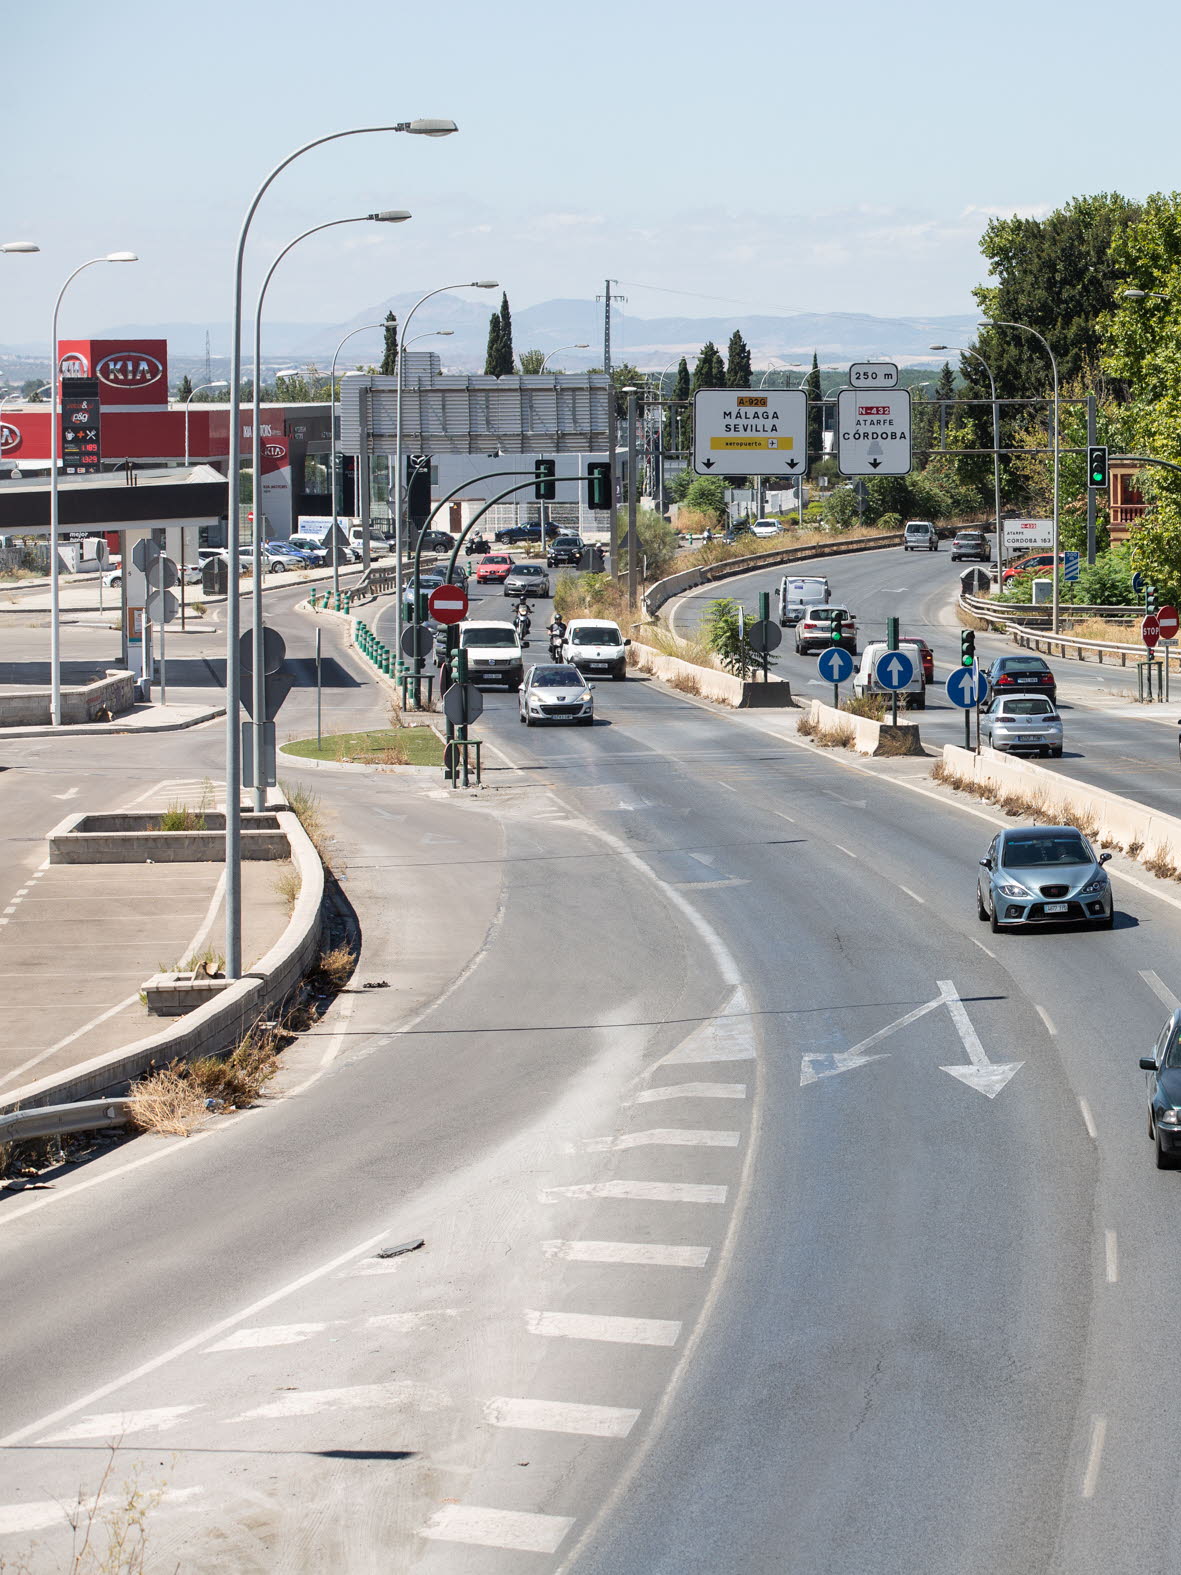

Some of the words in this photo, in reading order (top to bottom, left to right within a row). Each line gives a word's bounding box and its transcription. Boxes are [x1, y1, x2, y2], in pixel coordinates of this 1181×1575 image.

[107, 360, 152, 379] KIA
[855, 371, 878, 380] 250
[738, 398, 766, 406] A-92G
[723, 409, 780, 420] MÁLAGA
[724, 423, 778, 433] SEVILLA
[842, 429, 907, 440] CÓRDOBA
[264, 447, 281, 456] KIA
[1143, 627, 1160, 636] STOP
